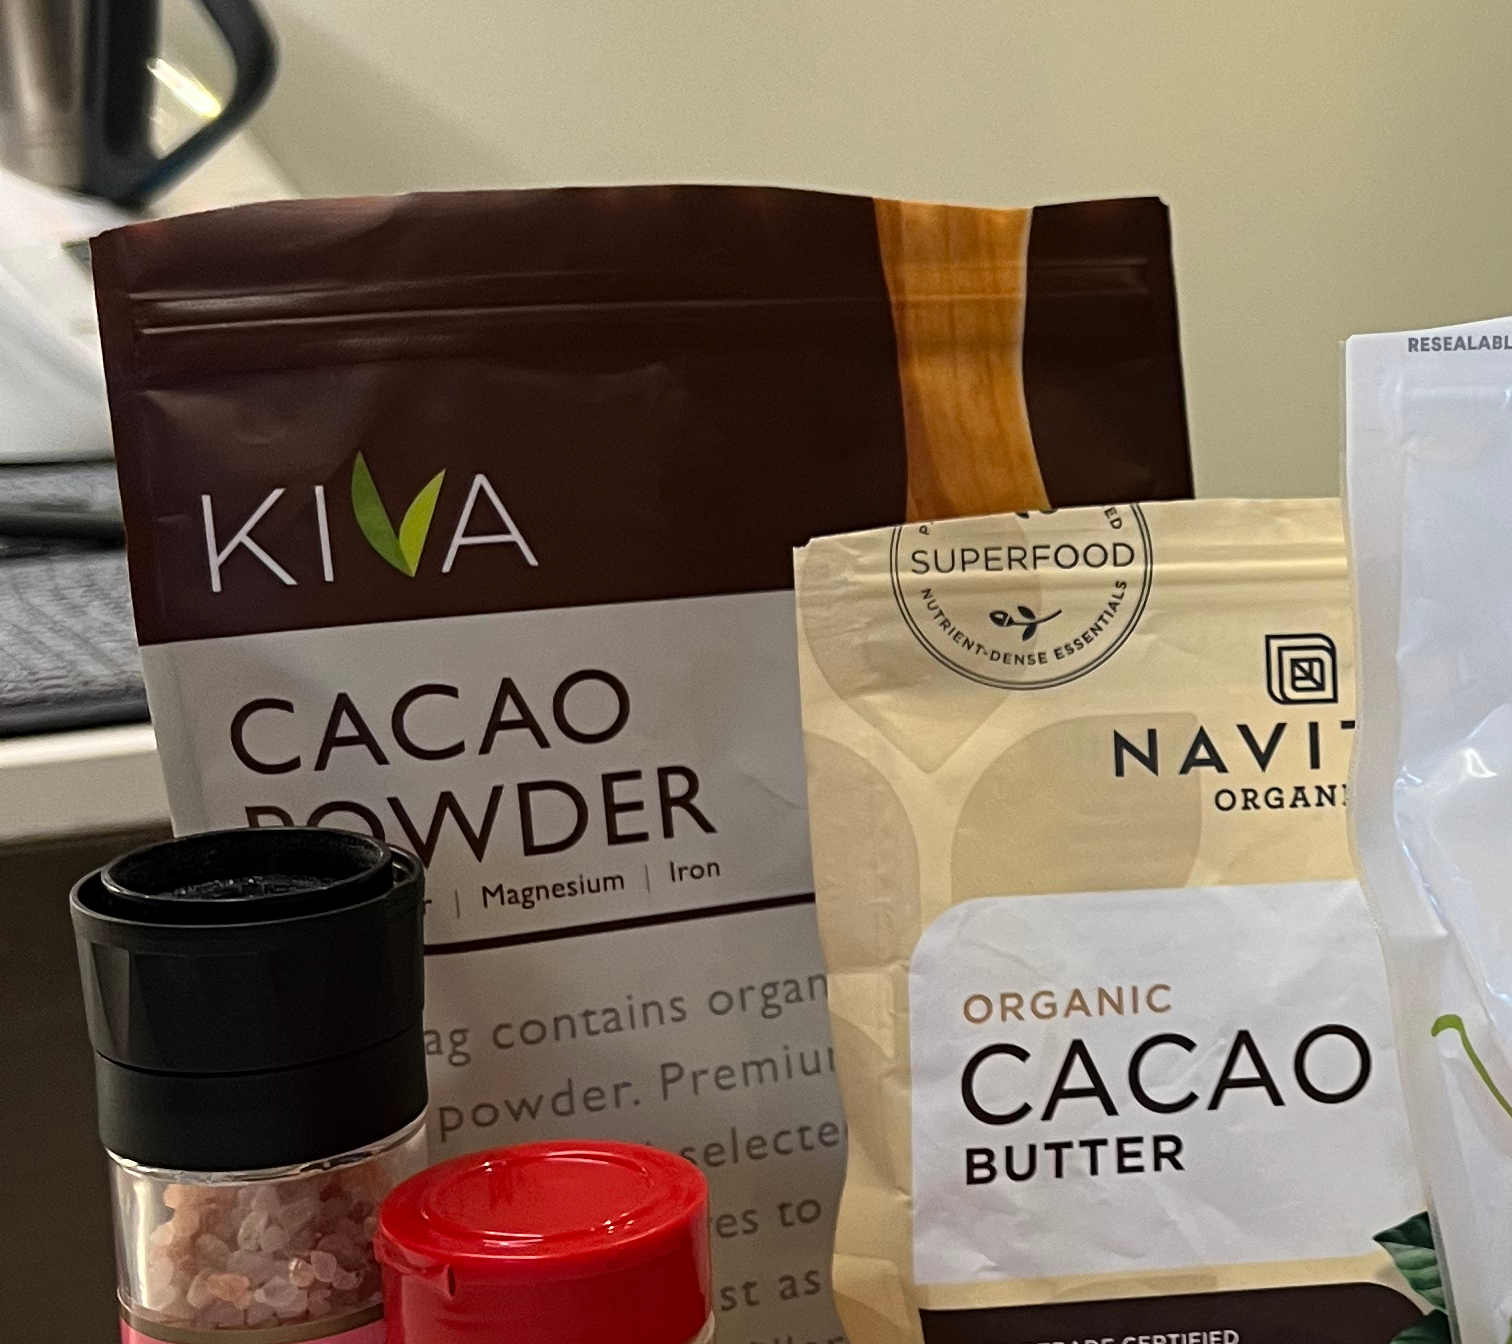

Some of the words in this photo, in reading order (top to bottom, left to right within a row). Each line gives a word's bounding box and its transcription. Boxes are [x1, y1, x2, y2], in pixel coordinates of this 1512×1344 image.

[200, 451, 539, 593] KIVA
[911, 542, 1135, 575] SUPERFOOD
[1053, 579, 1128, 661] ESSENTIALS
[230, 668, 631, 777] CACAO
[1214, 783, 1347, 812] ORGAN
[482, 872, 626, 912] Magnesium
[668, 859, 721, 883] Iron
[963, 983, 1172, 1025] ORGANIC
[425, 1028, 472, 1067] ag
[492, 994, 688, 1050] contains
[960, 1023, 1372, 1125] CACAO
[438, 1078, 642, 1144] powder.
[685, 1119, 848, 1167] selecte
[965, 1134, 1185, 1186] BUTTER
[779, 1199, 821, 1227] to
[778, 1270, 821, 1300] as
